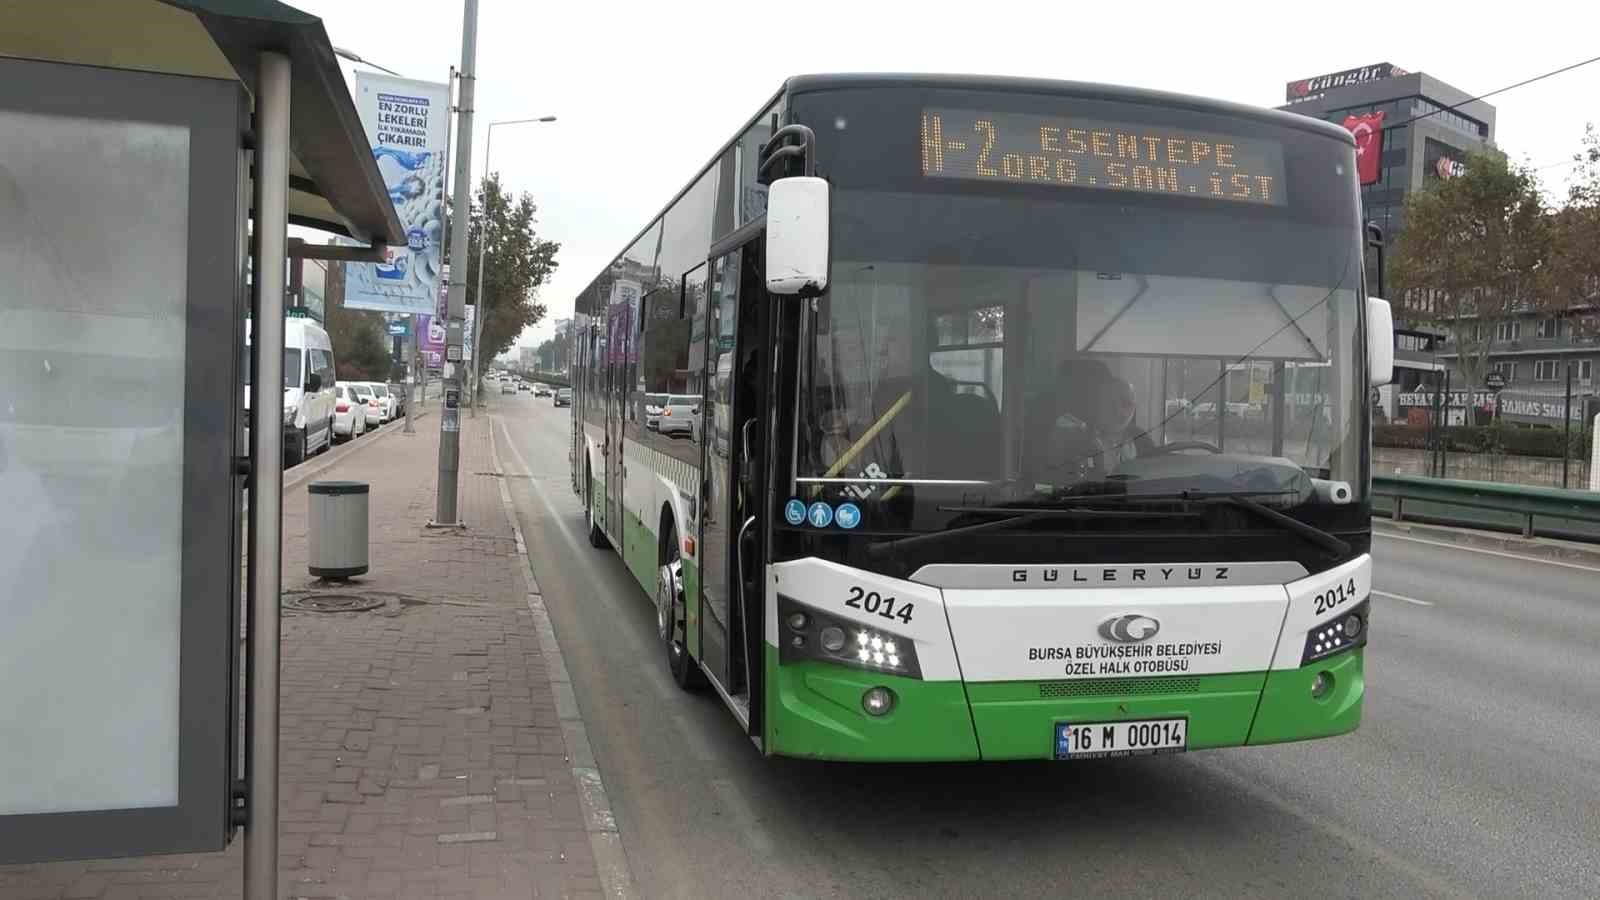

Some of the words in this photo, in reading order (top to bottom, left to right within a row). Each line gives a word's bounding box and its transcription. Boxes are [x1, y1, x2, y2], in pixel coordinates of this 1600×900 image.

[1308, 67, 1381, 91] Güngör
[378, 111, 427, 128] LEKELERİ
[379, 102, 392, 112] EN
[394, 103, 428, 116] ZORLU
[377, 132, 426, 148] ÇIKARIR!
[1039, 127, 1237, 169] ESENTEPE
[1012, 567, 1229, 582] GÜLERYÜZ
[845, 586, 915, 625] 2014
[1314, 578, 1356, 616] 2014
[1029, 647, 1072, 660] BURSA
[1075, 642, 1154, 659] BÜYÜKŞEHİR
[1156, 639, 1222, 657] BELEDİYESİ
[1065, 660, 1097, 676] ÖZEL
[1099, 661, 1131, 674] HALK
[1133, 656, 1189, 673] OTOBÜSÜ
[1072, 727, 1092, 750] 16
[1102, 726, 1115, 749] M
[1128, 723, 1181, 747] 00014
